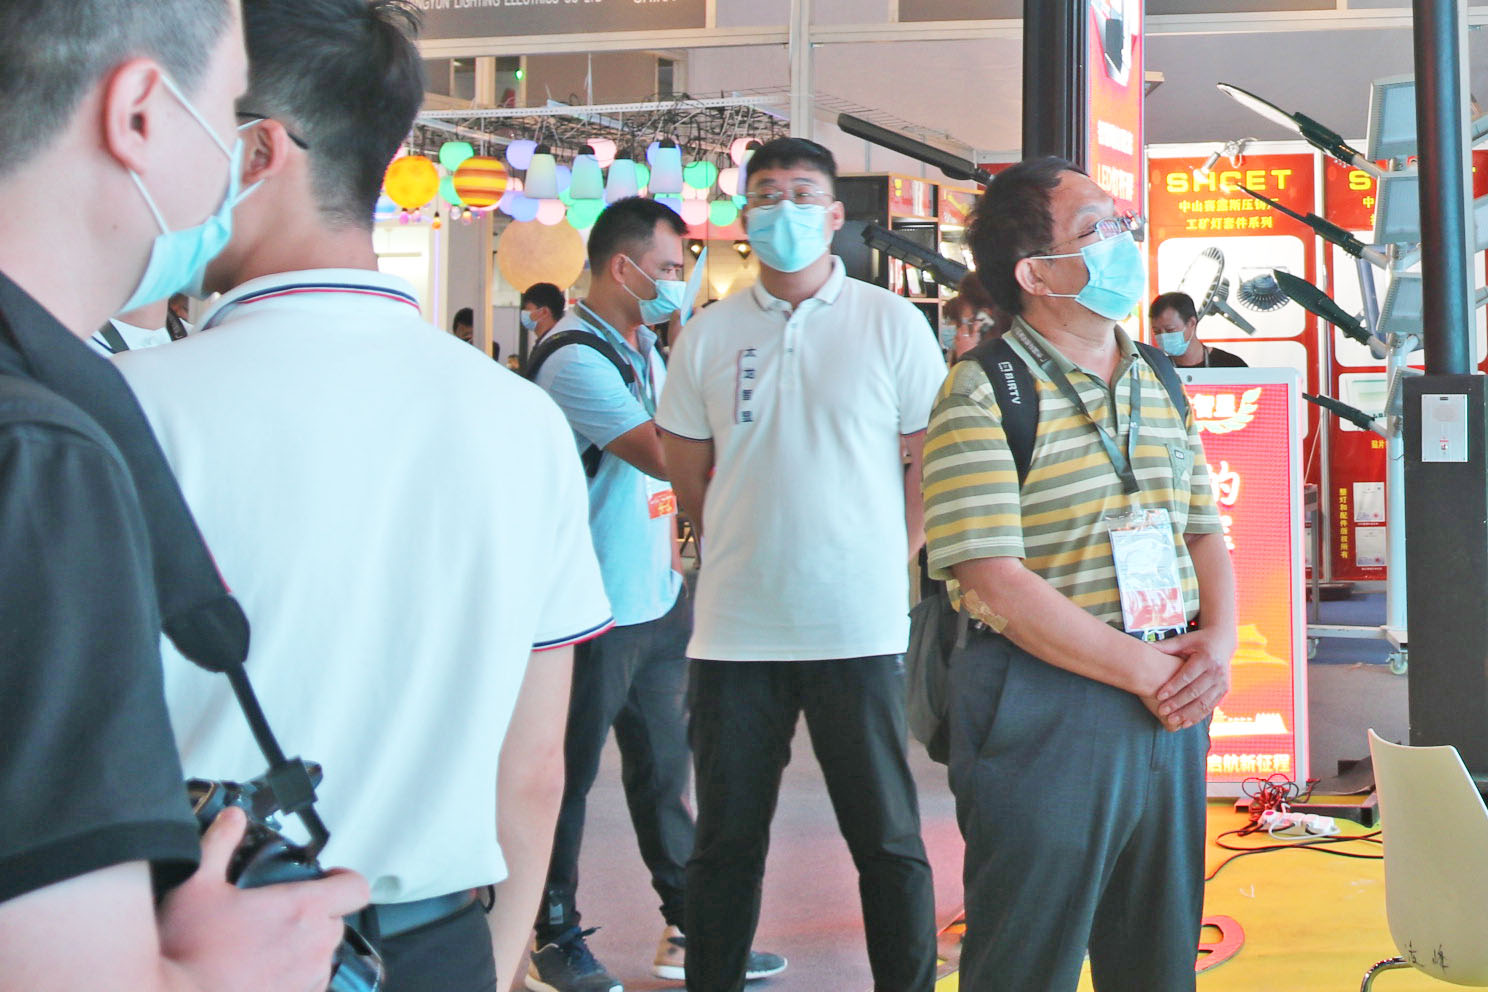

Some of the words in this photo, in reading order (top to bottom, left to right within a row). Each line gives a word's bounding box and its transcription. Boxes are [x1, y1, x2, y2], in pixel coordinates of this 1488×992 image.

[1166, 169, 1292, 193] SHCET
[1186, 216, 1274, 230] 工矿灯套件系列
